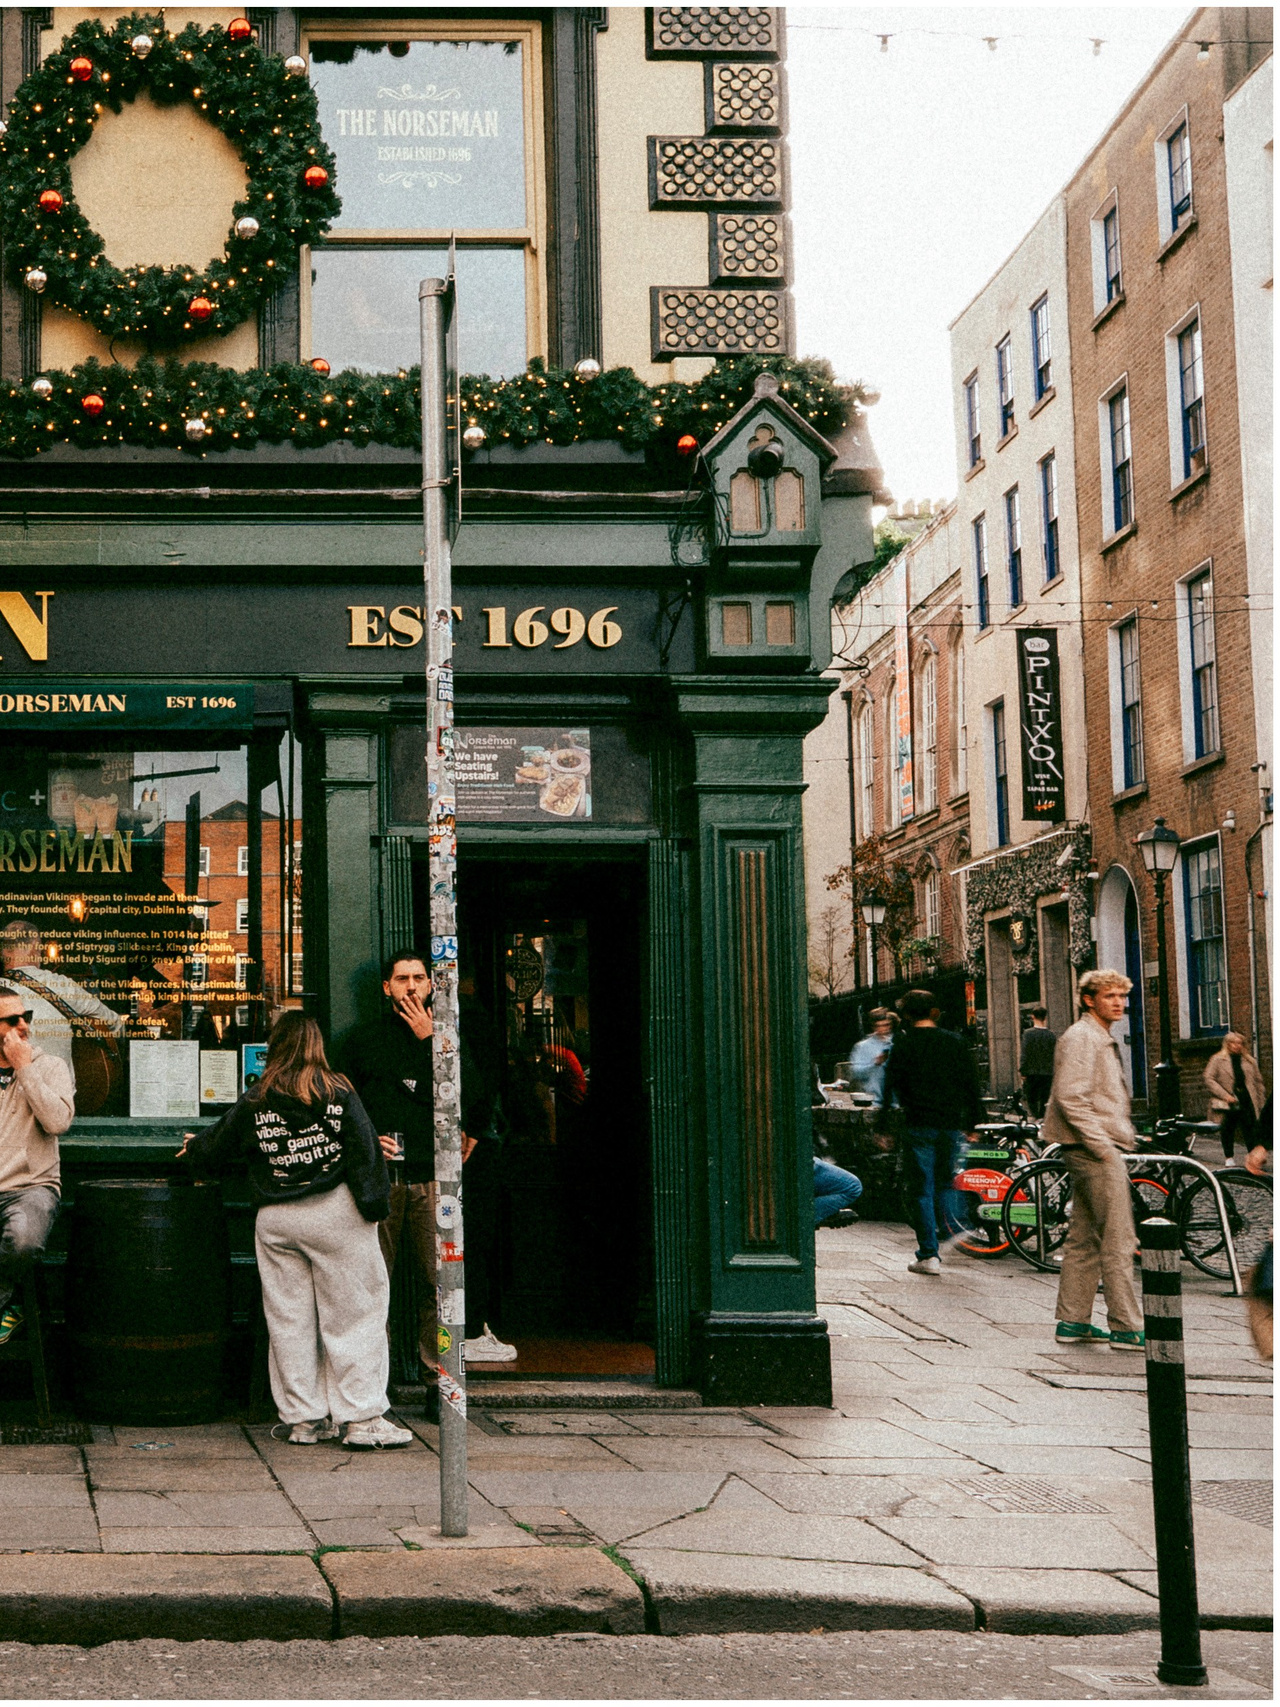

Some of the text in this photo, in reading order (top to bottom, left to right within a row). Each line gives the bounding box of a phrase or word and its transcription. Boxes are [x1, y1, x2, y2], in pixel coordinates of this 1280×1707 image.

[336, 109, 498, 138] THE NORSEMAN
[378, 146, 471, 162] ESTABLISHED 1696
[482, 606, 622, 648] 1696
[1030, 641, 1045, 649] bar
[166, 696, 195, 709] EST
[201, 697, 236, 709] 1696
[1026, 656, 1056, 761] PINTXO
[455, 752, 498, 760] We have
[455, 762, 493, 772] Seating
[455, 771, 499, 781] Upstairs!
[30, 789, 45, 806] +
[46, 893, 80, 903] Vikings
[82, 893, 111, 903] began
[113, 894, 122, 902] to
[125, 893, 154, 903] invade
[157, 893, 175, 903] and
[177, 893, 199, 903] then
[7, 905, 30, 915] They
[30, 905, 70, 914] founded
[89, 905, 120, 915] capital
[122, 906, 141, 916] city,
[143, 905, 177, 914] Dublin
[179, 906, 186, 914] in
[28, 931, 38, 939] to
[40, 930, 71, 939] reduce
[73, 930, 102, 941] viking
[104, 931, 149, 939] influence.
[151, 931, 160, 939] In
[162, 931, 185, 939] 1014
[187, 931, 199, 939] he
[201, 931, 229, 941] pitted
[18, 942, 32, 951] the
[64, 942, 75, 951] of
[76, 942, 115, 953] Sigtrygg
[117, 943, 164, 953] Silkbeard,
[166, 943, 187, 953] King
[189, 943, 201, 952] of
[201, 943, 234, 953] Dublin,
[14, 954, 64, 965] contingent
[66, 955, 81, 963] led
[82, 954, 94, 966] by
[96, 955, 126, 965] Sigurd
[128, 955, 138, 964] of
[176, 956, 183, 964] &
[185, 956, 214, 964] Brodir
[215, 955, 226, 964] of
[89, 980, 99, 989] of
[101, 980, 115, 989] the
[117, 980, 147, 991] Viking
[149, 980, 180, 989] forces.
[182, 981, 190, 989] It
[190, 981, 198, 989] is
[199, 981, 246, 989] estimated
[99, 992, 116, 1000] but
[118, 992, 132, 1000] the
[134, 992, 156, 1003] high
[158, 993, 179, 1003] king
[180, 992, 216, 1001] himself
[236, 992, 266, 1001] killed.
[33, 1016, 92, 1027] considerably
[136, 1017, 168, 1027] defeat,
[76, 1030, 82, 1038] &
[85, 1029, 119, 1038] cultural
[122, 1030, 159, 1040] identity
[256, 1126, 292, 1140] vibes,
[260, 1133, 329, 1152] the game,
[313, 1146, 324, 1159] it
[963, 1176, 996, 1184] FREENOW
